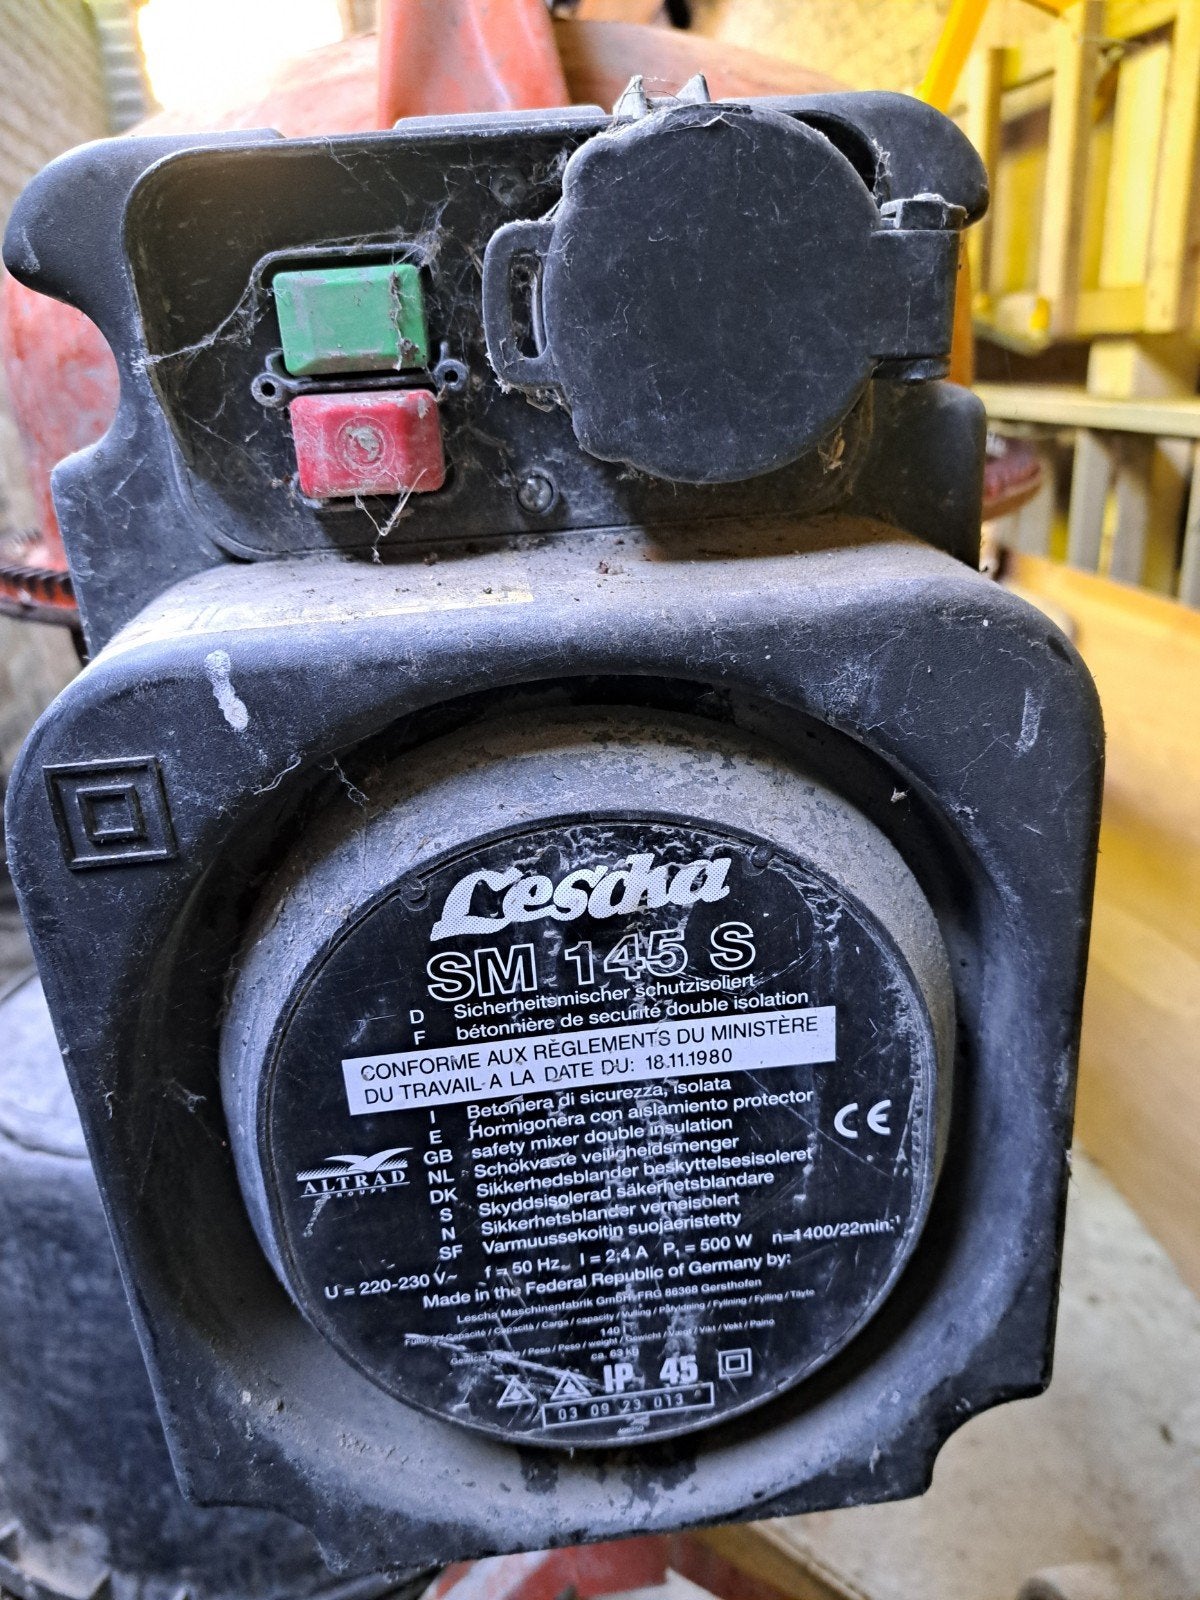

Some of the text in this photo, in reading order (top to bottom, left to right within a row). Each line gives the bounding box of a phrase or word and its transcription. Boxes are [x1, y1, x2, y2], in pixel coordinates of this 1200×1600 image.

[430, 853, 731, 941] Lescha
[427, 921, 756, 1001] SM 145 S
[410, 974, 755, 1024] D Sicherheitsmischer schutzisoliert
[414, 991, 809, 1046] F bétonnière de securité double isolation
[361, 1053, 481, 1082] CONFORME
[487, 1046, 528, 1067] AUX
[677, 1027, 705, 1045] DU
[711, 1014, 818, 1042] MINISTÈRE
[365, 1047, 733, 1105] DU TRAVAIL A LA DATE DU: 18.11.1980
[430, 1078, 731, 1124] I Betoniera di sicurezza, isolata
[424, 1117, 733, 1165] GB safety mixer double insulation
[430, 1090, 814, 1144] E Hormigonera con aislamiento protector
[304, 1170, 406, 1194] ALTRAD
[428, 1136, 740, 1184] NL Schokvaste veiligheidsmenger
[430, 1148, 813, 1204] DK Sikkerhedsblander beskyttelsesisoleret
[440, 1172, 775, 1222] S Skyddsisolerad säkerhetsblandare
[442, 1192, 740, 1241] N Sikkerhetsblander verneisolert
[439, 1211, 742, 1261] SF Varmuussekoitin suojaeristetty
[325, 1285, 339, 1299] U
[360, 1273, 430, 1296] 220-230
[485, 1266, 493, 1279] f
[512, 1260, 532, 1275] 50
[635, 1245, 649, 1259] A
[700, 1236, 731, 1252] 500
[735, 1233, 752, 1248] W
[423, 1252, 791, 1308] Made in the Federal Republic of Germany by:
[457, 1311, 498, 1324] Lescha
[501, 1298, 593, 1318] Maschinenfabrik
[637, 1289, 662, 1300] FRG
[665, 1284, 698, 1297] 86368
[701, 1278, 762, 1294] Gersthofen
[601, 1326, 621, 1337] 140
[603, 1354, 698, 1394] IP 45
[558, 1406, 579, 1422] 03
[590, 1402, 610, 1418] 09
[653, 1392, 684, 1409] 013
